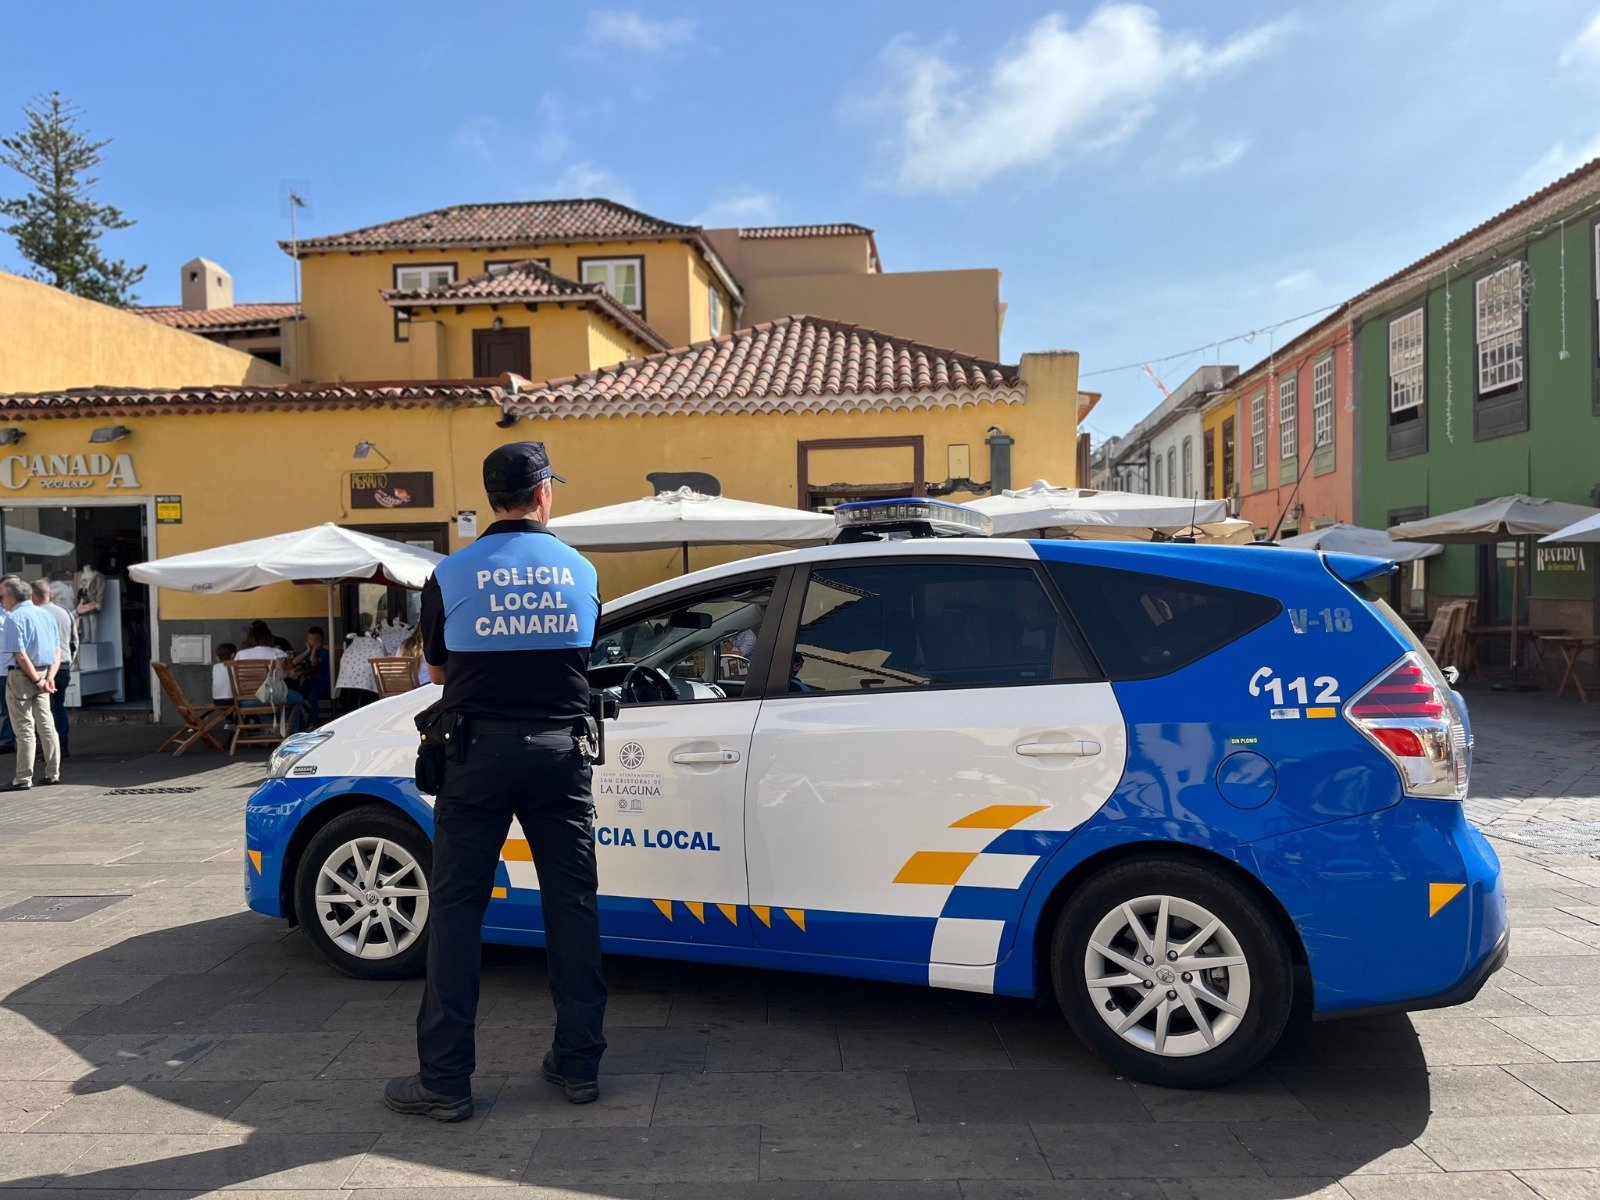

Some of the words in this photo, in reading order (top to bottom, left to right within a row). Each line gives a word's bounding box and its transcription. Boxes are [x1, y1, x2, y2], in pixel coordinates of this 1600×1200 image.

[0, 453, 140, 490] CANADA
[1537, 547, 1586, 571] RESERVA
[477, 567, 575, 590] POLICIA
[490, 591, 568, 612] LOCAL
[475, 614, 579, 636] CANARIA
[1288, 608, 1353, 634] V-18
[1264, 676, 1341, 705] 112
[600, 785, 613, 794] LA
[616, 786, 660, 796] LAGUNA
[644, 829, 720, 851] LOCAL
